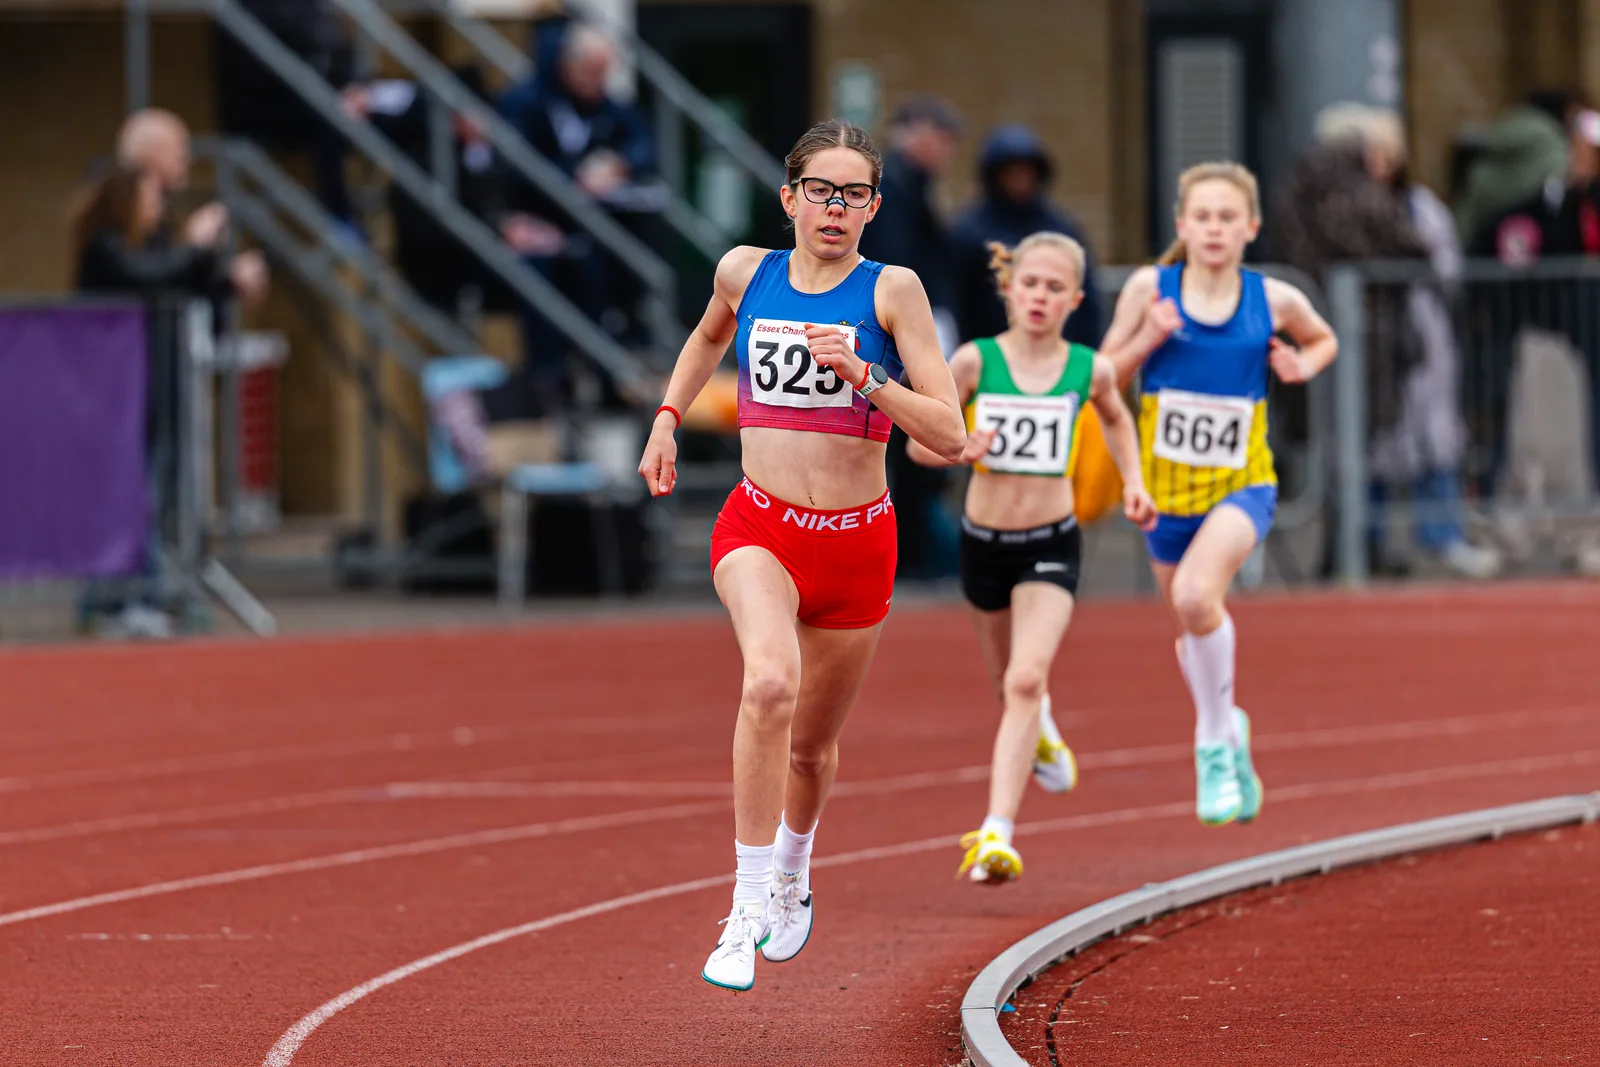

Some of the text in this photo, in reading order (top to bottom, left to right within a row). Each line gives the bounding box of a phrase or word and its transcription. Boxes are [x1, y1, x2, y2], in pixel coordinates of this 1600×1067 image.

[756, 323, 780, 334] Essex
[755, 341, 844, 395] 325
[986, 416, 1059, 460] 321
[1165, 410, 1239, 455] 664
[741, 476, 893, 531] RO NIKE PR
